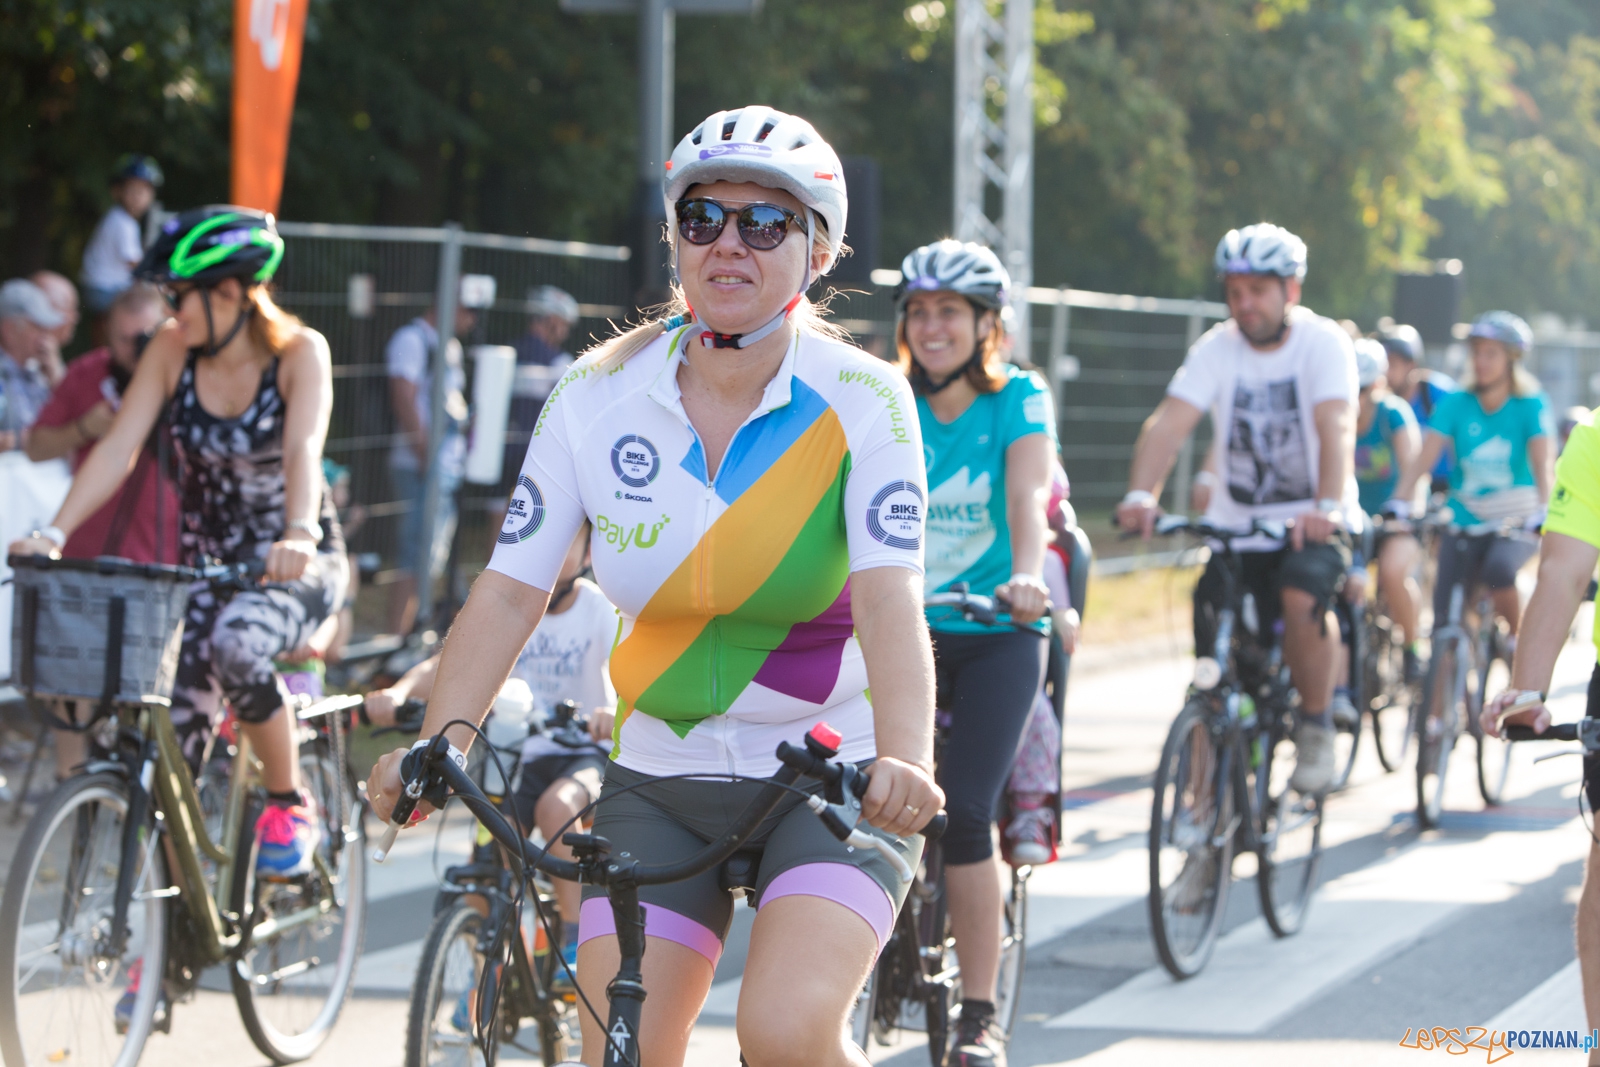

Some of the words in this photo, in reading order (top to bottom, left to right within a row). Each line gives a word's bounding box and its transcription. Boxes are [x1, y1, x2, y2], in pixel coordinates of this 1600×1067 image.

[626, 451, 646, 461] BIKE
[622, 458, 649, 467] CHALLENGE
[890, 504, 918, 516] BIKE
[596, 514, 670, 554] PayU
